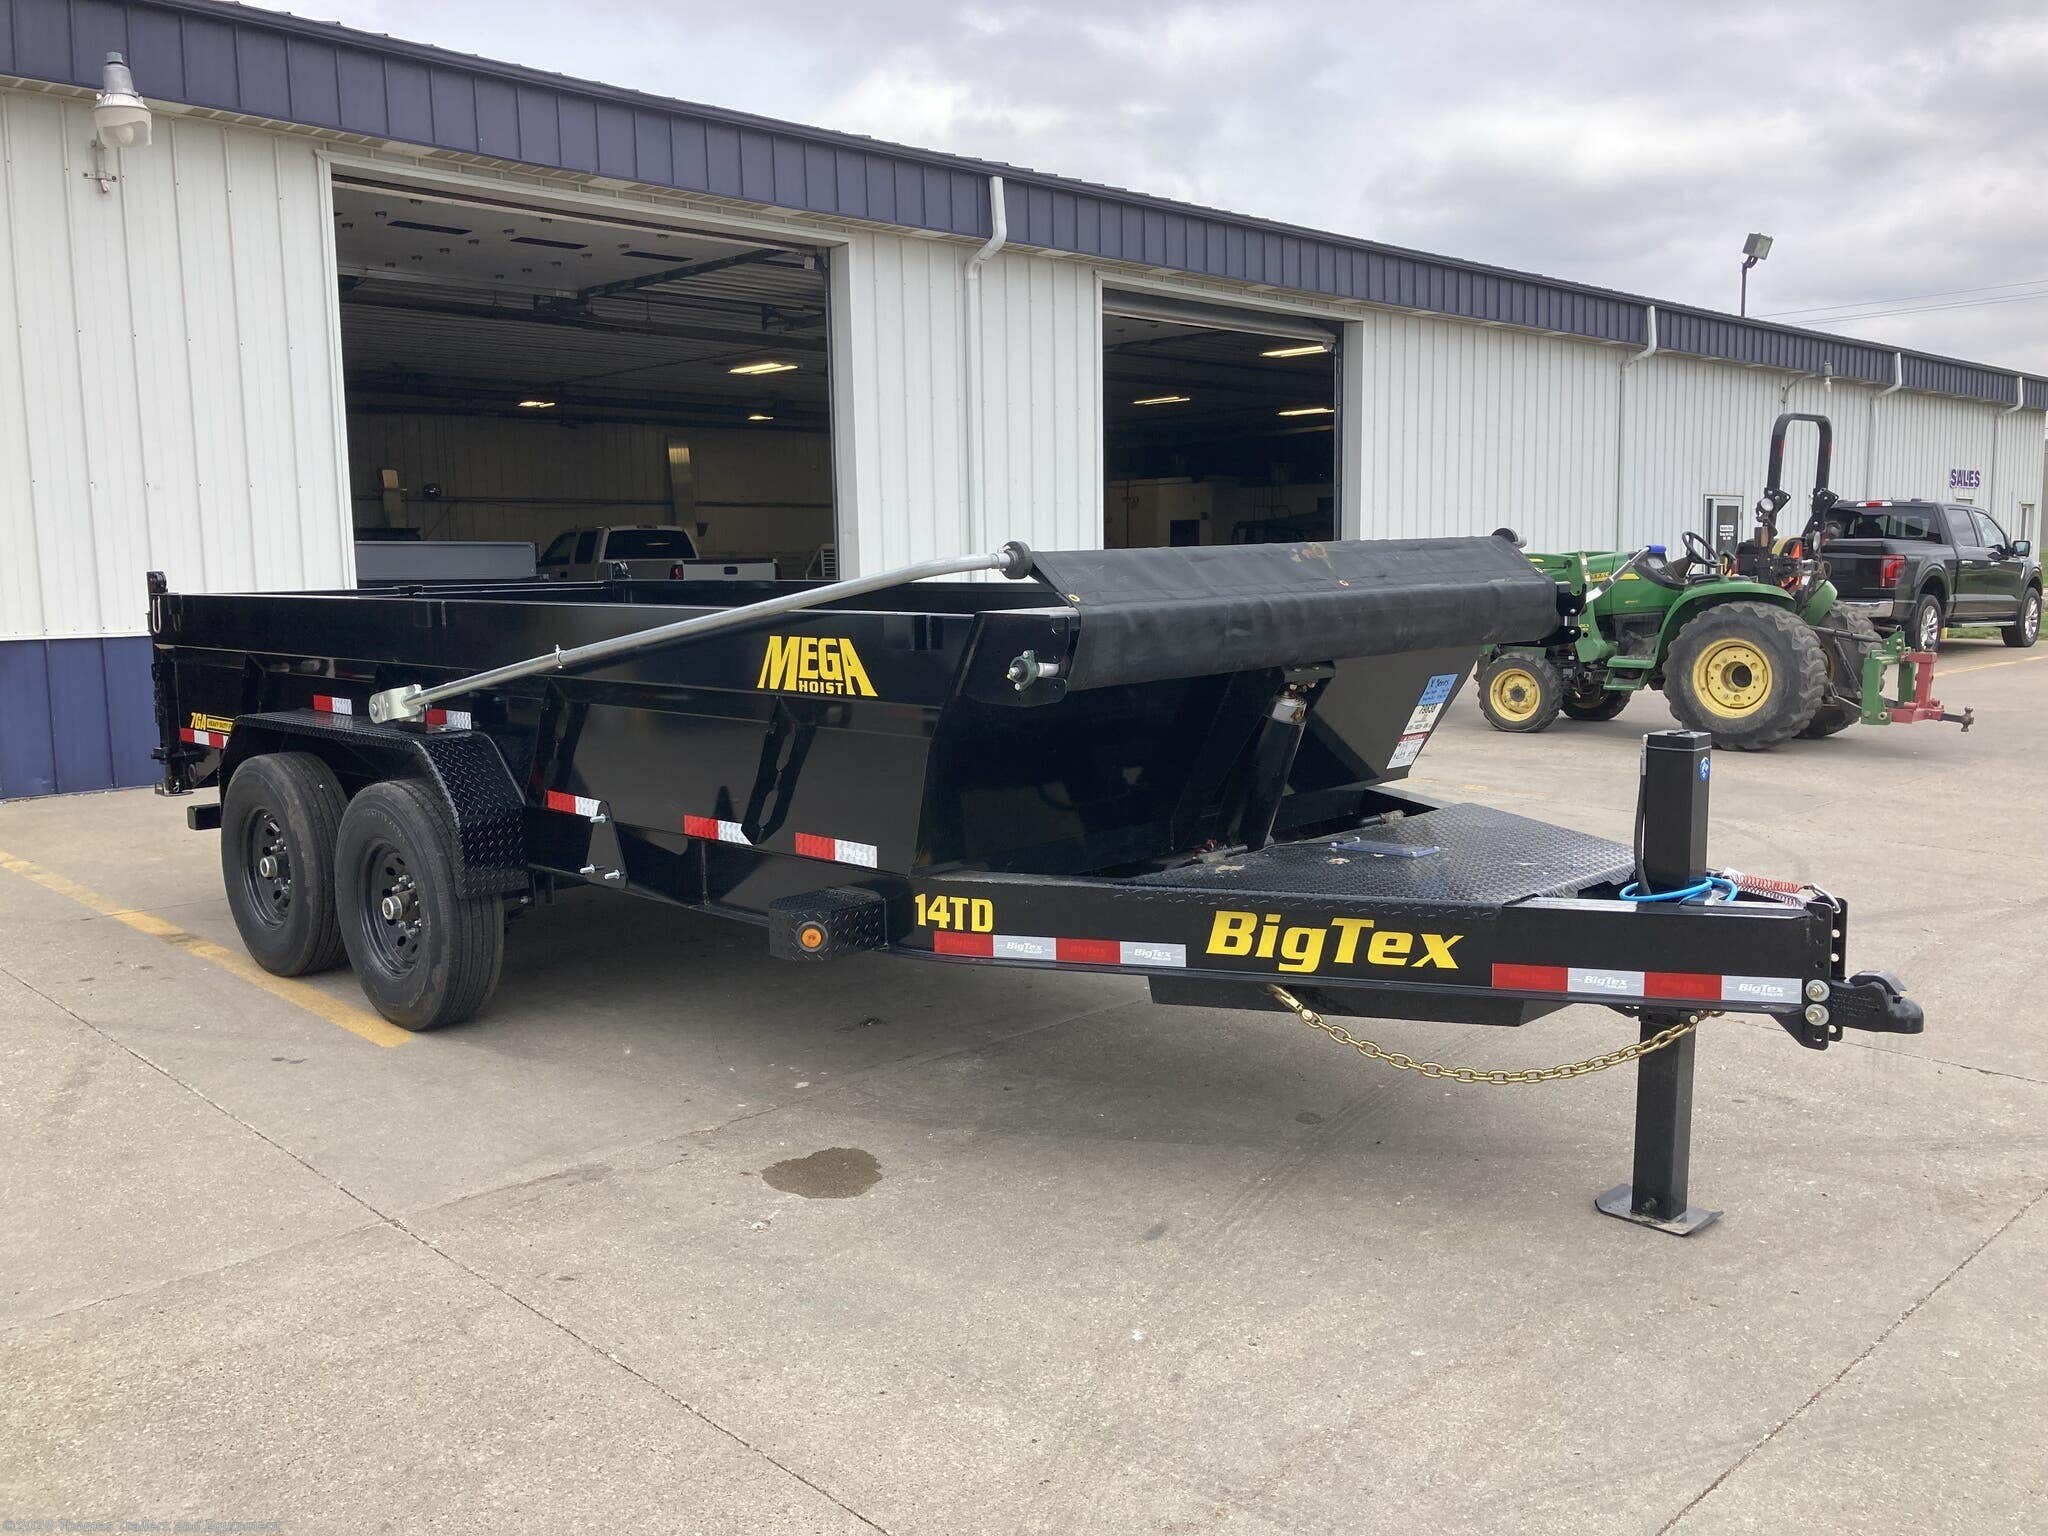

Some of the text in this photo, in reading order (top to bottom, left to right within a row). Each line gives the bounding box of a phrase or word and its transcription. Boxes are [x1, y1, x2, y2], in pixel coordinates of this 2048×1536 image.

[1950, 468, 1981, 488] SALES
[757, 635, 878, 697] MEGA
[798, 680, 844, 695] HOIST
[914, 893, 993, 933] 14TD
[1006, 941, 1043, 952] BigTex
[1205, 910, 1464, 973] BigTex
[1134, 948, 1172, 959] BigTex
[1583, 974, 1629, 986] BigTex
[1738, 983, 1784, 995] BigTex
